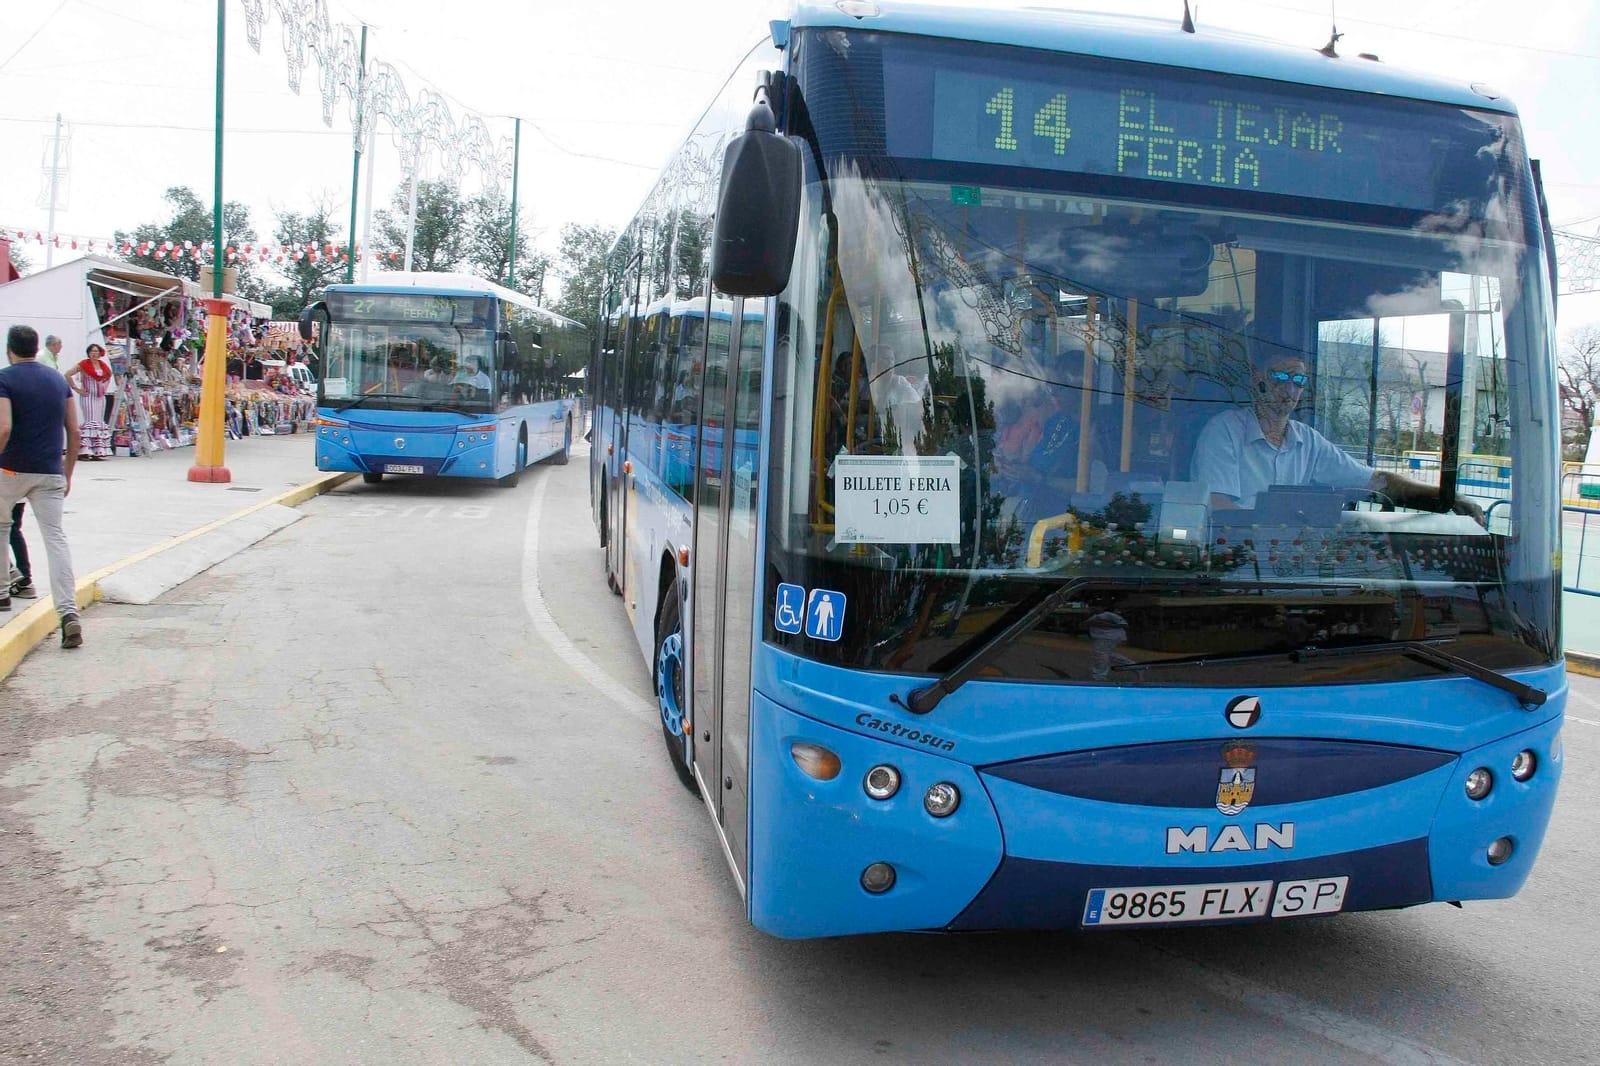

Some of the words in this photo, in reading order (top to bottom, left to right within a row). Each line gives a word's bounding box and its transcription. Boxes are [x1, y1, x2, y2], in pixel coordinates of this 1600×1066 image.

[985, 87, 1072, 156] 14
[1119, 88, 1175, 134] EL
[1209, 98, 1344, 154] TEJAR
[1117, 133, 1260, 187] FERIA
[353, 299, 376, 313] 27
[403, 308, 438, 319] FERIA
[842, 476, 902, 491] BILLETE
[909, 477, 952, 492] FERIA
[873, 498, 910, 518] 1,05
[917, 498, 929, 515] €
[855, 712, 956, 752] Castrosua
[1166, 822, 1296, 855] MAN
[1089, 910, 1098, 919] E
[1107, 890, 1187, 919] 9865
[1199, 886, 1260, 915] FLX
